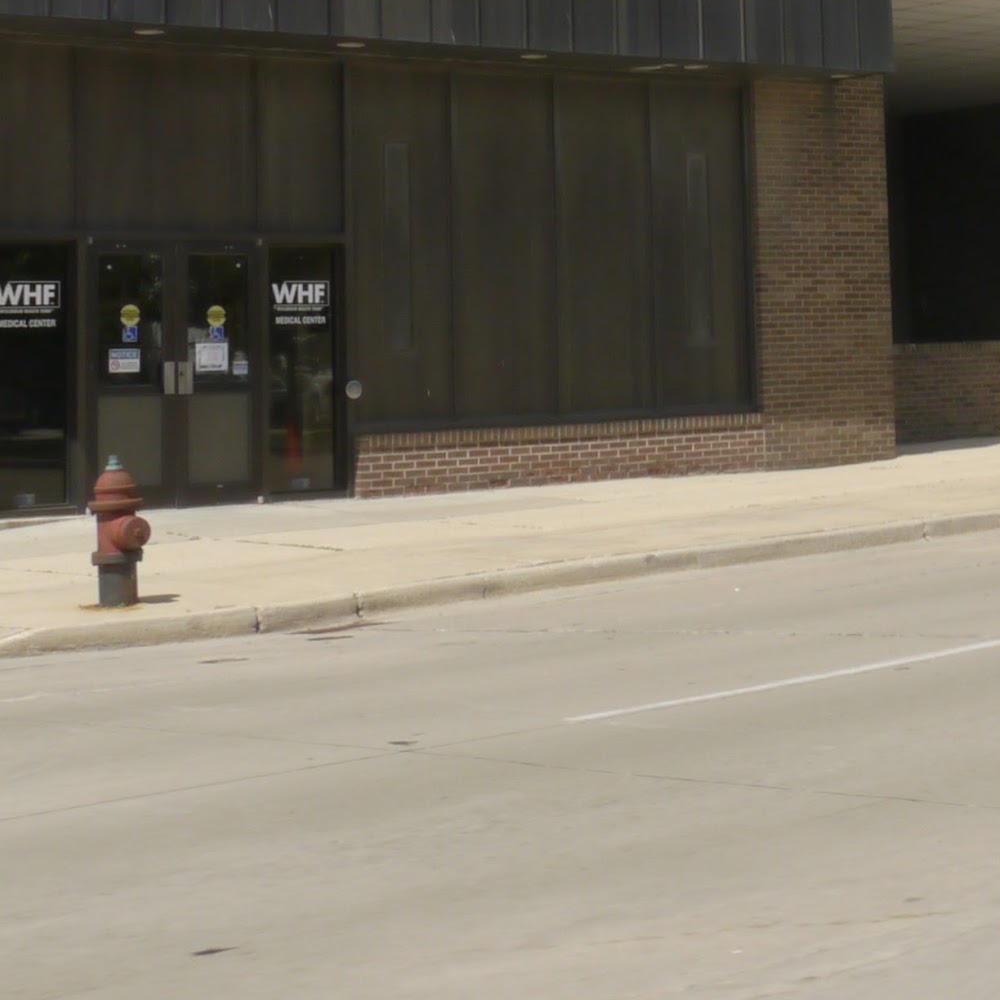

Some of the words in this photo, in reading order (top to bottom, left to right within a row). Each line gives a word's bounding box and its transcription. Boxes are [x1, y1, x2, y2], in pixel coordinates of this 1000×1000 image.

[0, 283, 56, 305] WHF
[271, 282, 325, 304] WHF
[28, 319, 57, 328] CENTER
[275, 315, 301, 325] MEDICAL
[302, 315, 326, 325] CENTER
